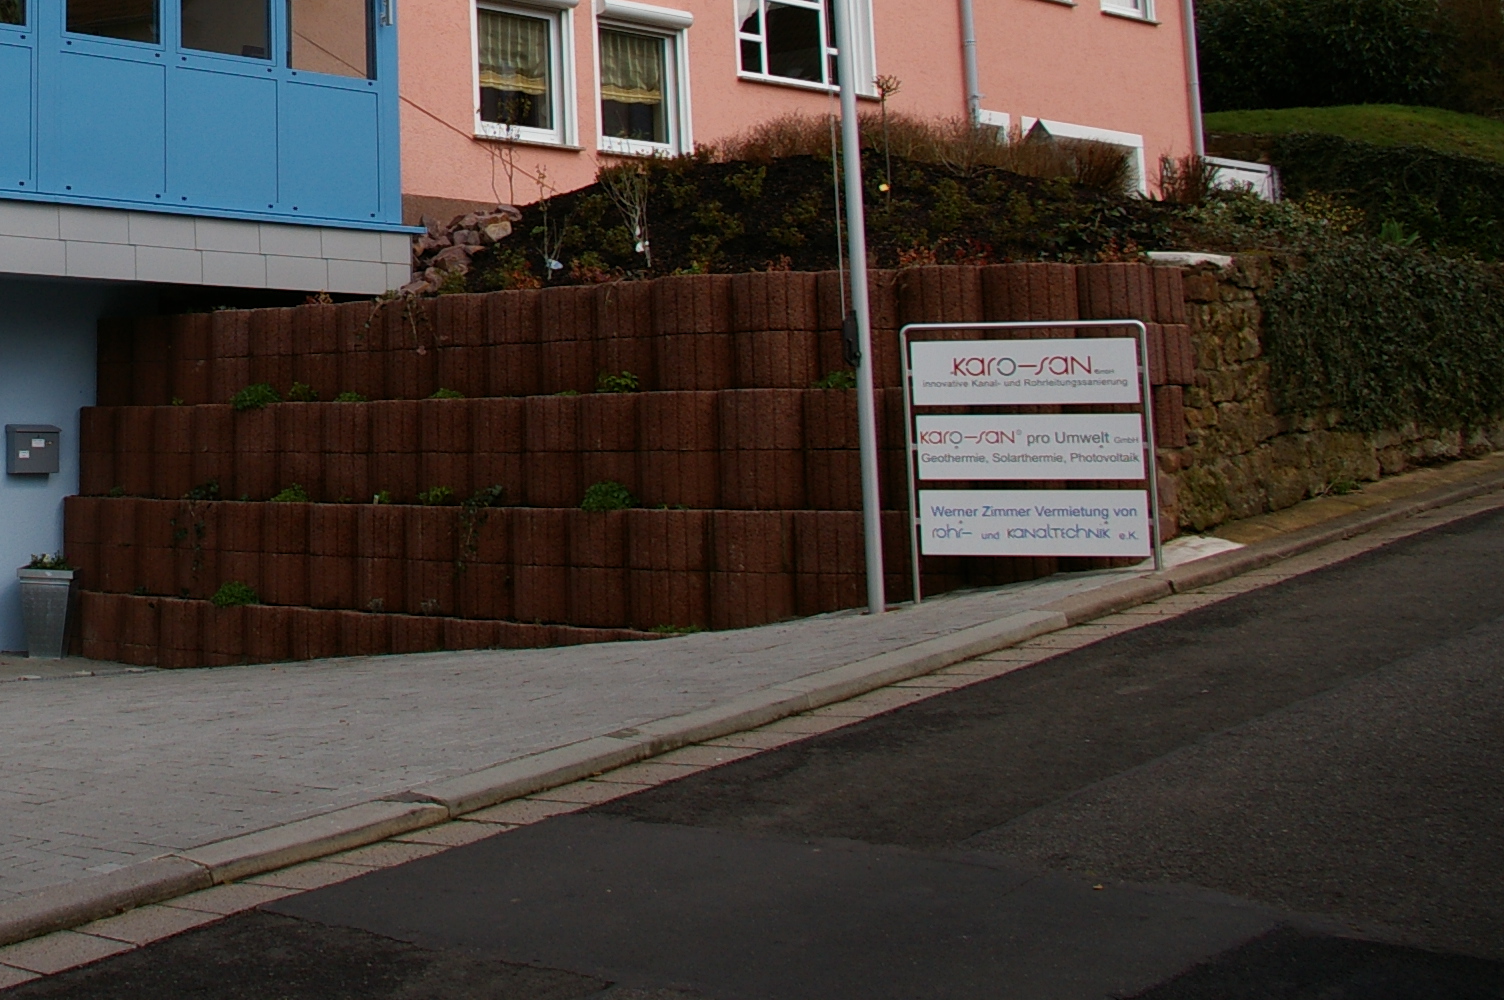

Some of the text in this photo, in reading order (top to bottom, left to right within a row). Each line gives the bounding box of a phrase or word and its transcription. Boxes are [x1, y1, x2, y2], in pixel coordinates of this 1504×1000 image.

[922, 377, 1128, 388] innovative Kanal- und Rohrleitungssanierung
[1026, 434, 1051, 447] pro
[1054, 431, 1110, 444] Umwelt
[1113, 436, 1139, 444] GmbH
[920, 452, 1140, 464] Geothermie, Solarthermie, Photovoltaik
[930, 505, 1138, 520] Werner Zimmer Vermietung von
[932, 523, 973, 539] rohr-
[981, 531, 1000, 540] und
